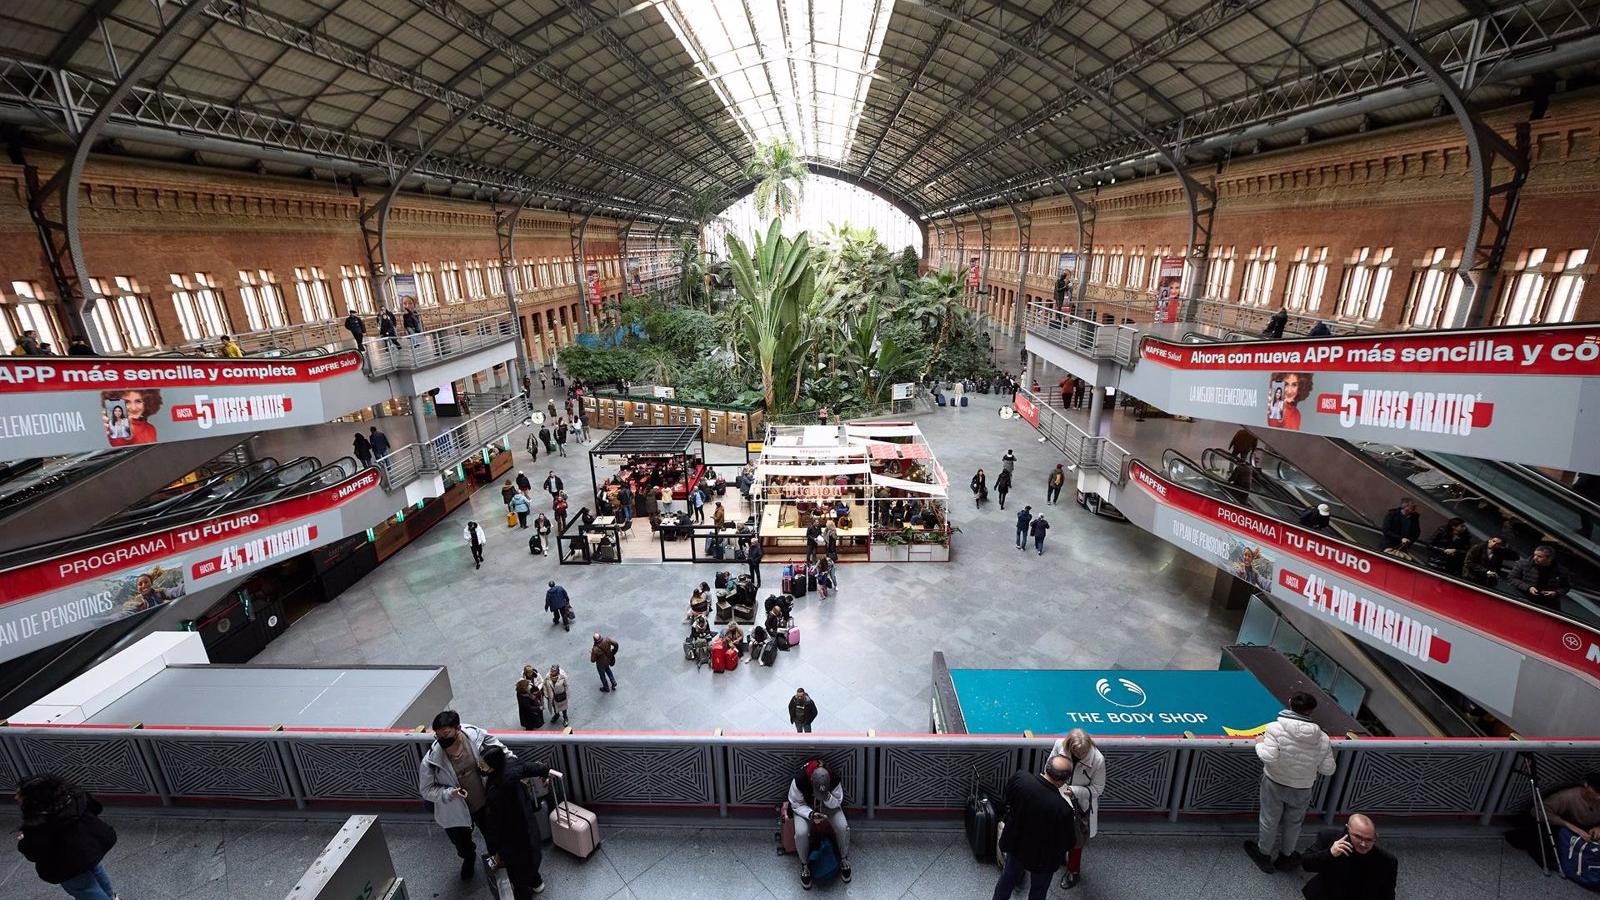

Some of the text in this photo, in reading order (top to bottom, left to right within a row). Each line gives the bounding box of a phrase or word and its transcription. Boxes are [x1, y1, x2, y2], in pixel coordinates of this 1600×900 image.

[308, 357, 357, 376] MAPFRE Salud
[1145, 345, 1182, 362] MAPFRE Salud
[1190, 350, 1226, 364] Ahora
[1227, 352, 1252, 364] con
[1254, 351, 1301, 364] nueva
[1303, 345, 1344, 363] APP
[1347, 343, 1396, 363] más
[1401, 340, 1514, 363] sencilla
[1520, 343, 1544, 366] y
[0, 364, 297, 384] APP más sencilla y completa
[194, 394, 213, 430] 5
[213, 397, 250, 425] MESES
[1321, 397, 1337, 410] HASTA
[1339, 383, 1359, 428] 5
[1360, 388, 1409, 429] MESES
[338, 473, 374, 498] MAPFRE
[1138, 471, 1167, 497] MAPFRE
[59, 513, 260, 578] PROGRAMA TU FUTURO
[1217, 507, 1371, 574] PROGRAMA TU FUTURO
[220, 544, 244, 574] 4%
[244, 539, 266, 567] POR
[20, 613, 41, 639] DE
[41, 590, 113, 633] PENSIONES
[1303, 573, 1328, 613] 4%
[1330, 585, 1357, 626] POR
[1066, 712, 1209, 724] THE BODY SHOP
